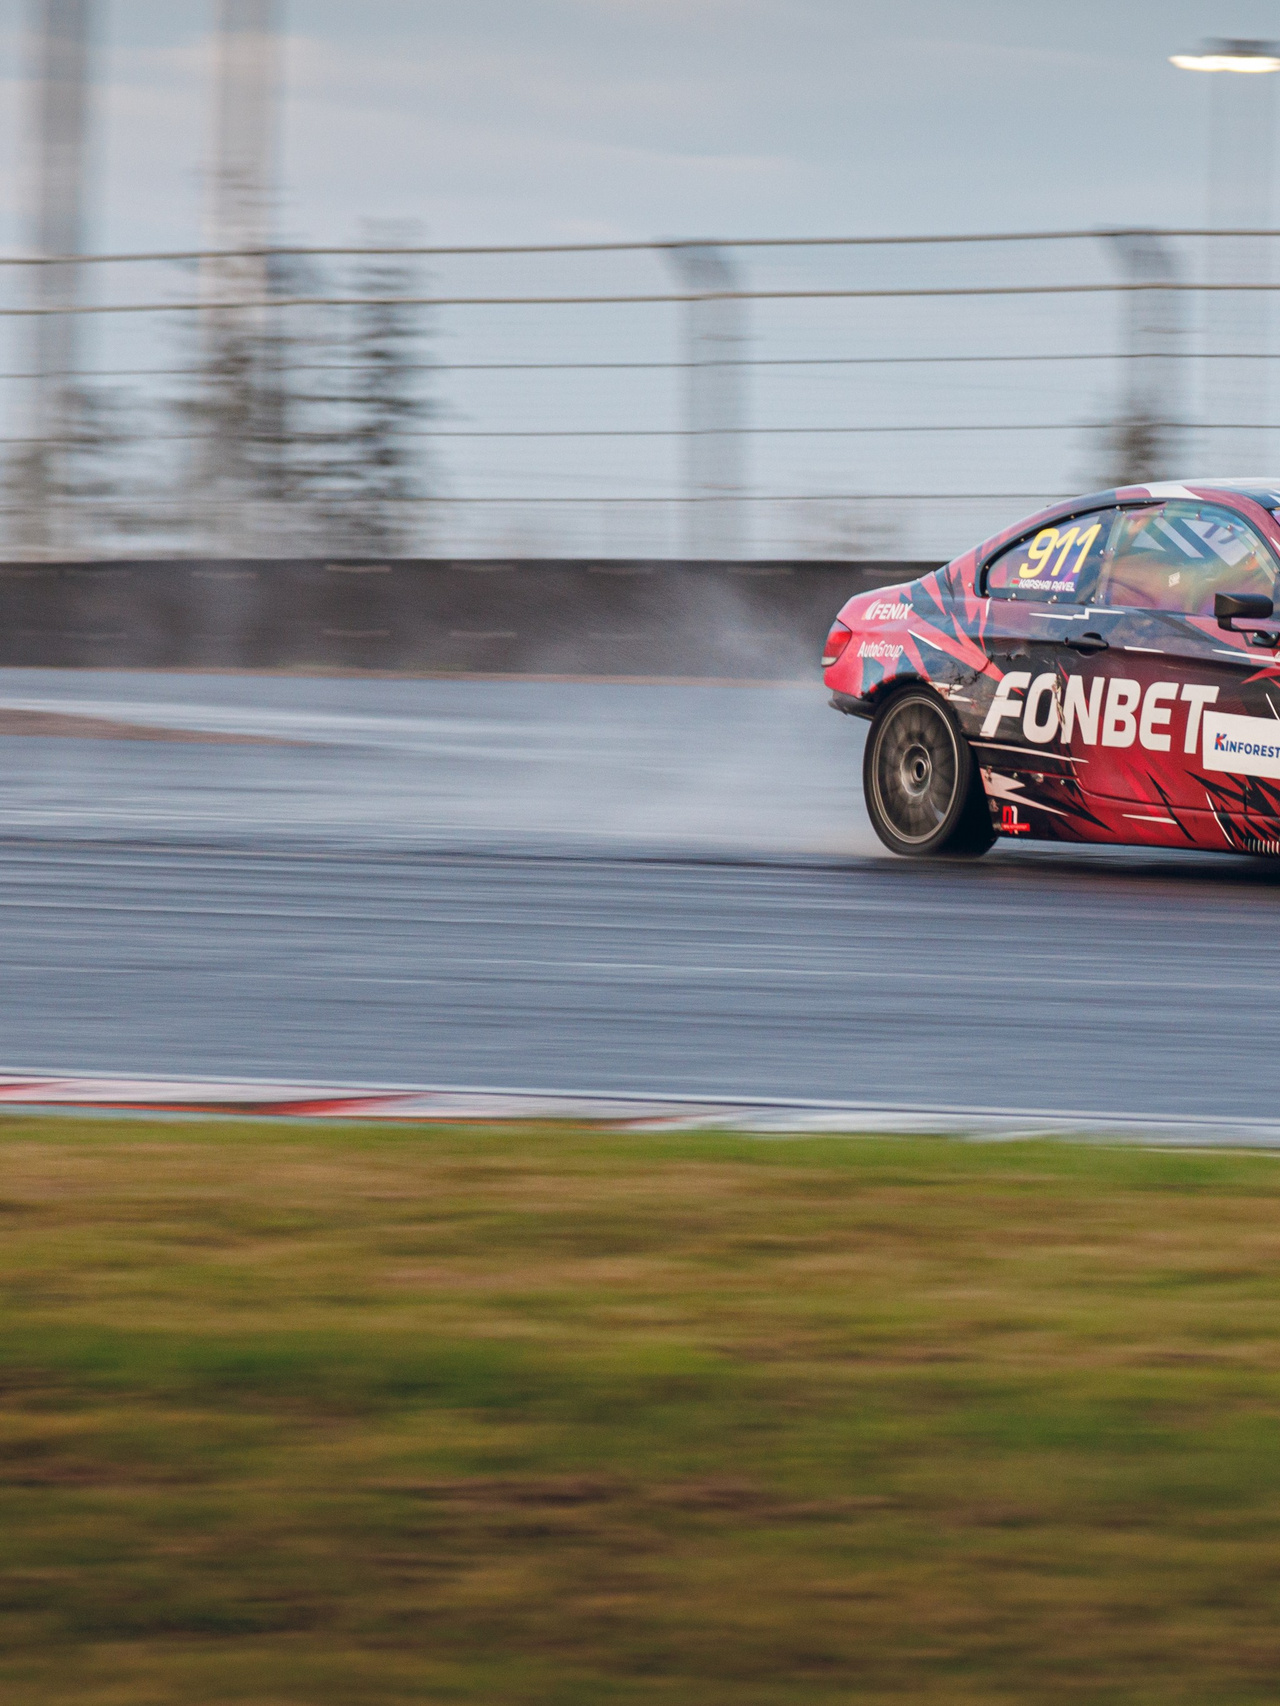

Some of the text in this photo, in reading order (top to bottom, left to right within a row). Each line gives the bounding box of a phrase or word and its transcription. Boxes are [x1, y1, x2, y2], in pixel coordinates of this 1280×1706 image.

[1018, 523, 1102, 579] 911
[872, 602, 914, 620] FENIX
[857, 640, 904, 661] AutoGroup
[979, 671, 1220, 755] FONBET
